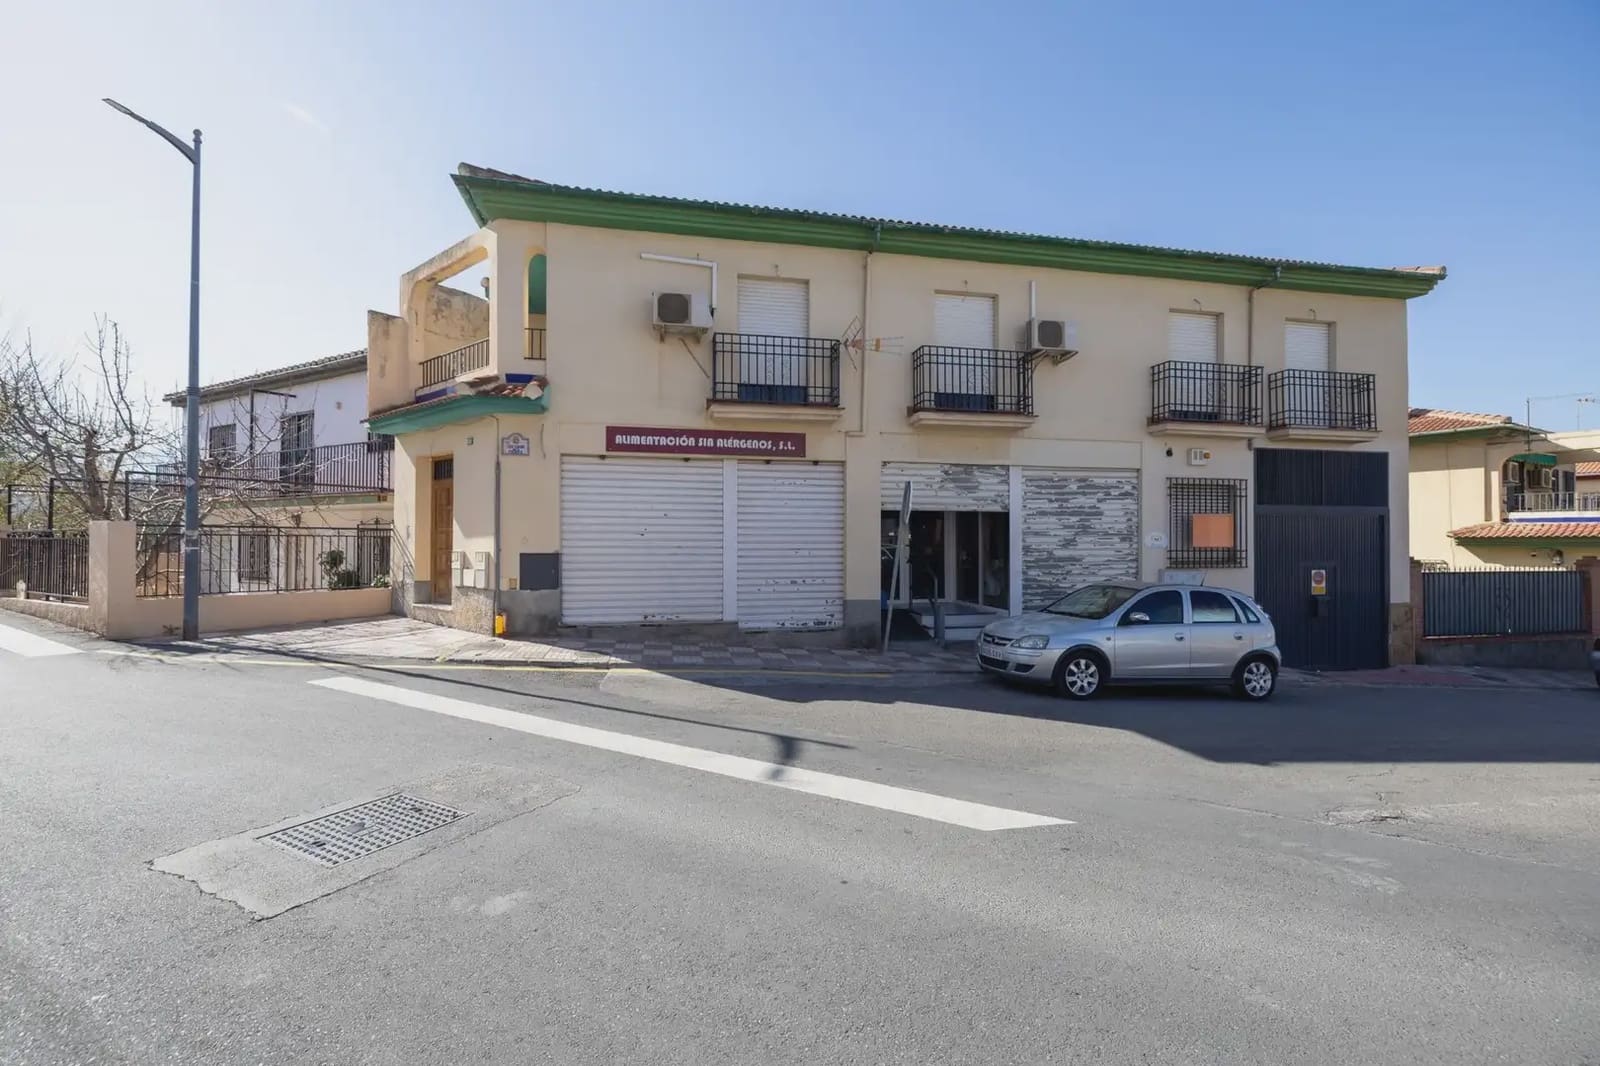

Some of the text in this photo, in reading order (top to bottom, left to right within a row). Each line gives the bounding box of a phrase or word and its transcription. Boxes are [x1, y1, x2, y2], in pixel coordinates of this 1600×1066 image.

[615, 434, 796, 451] ALIMENTACIÓN SIN ALÉRGENOS, S.L.
